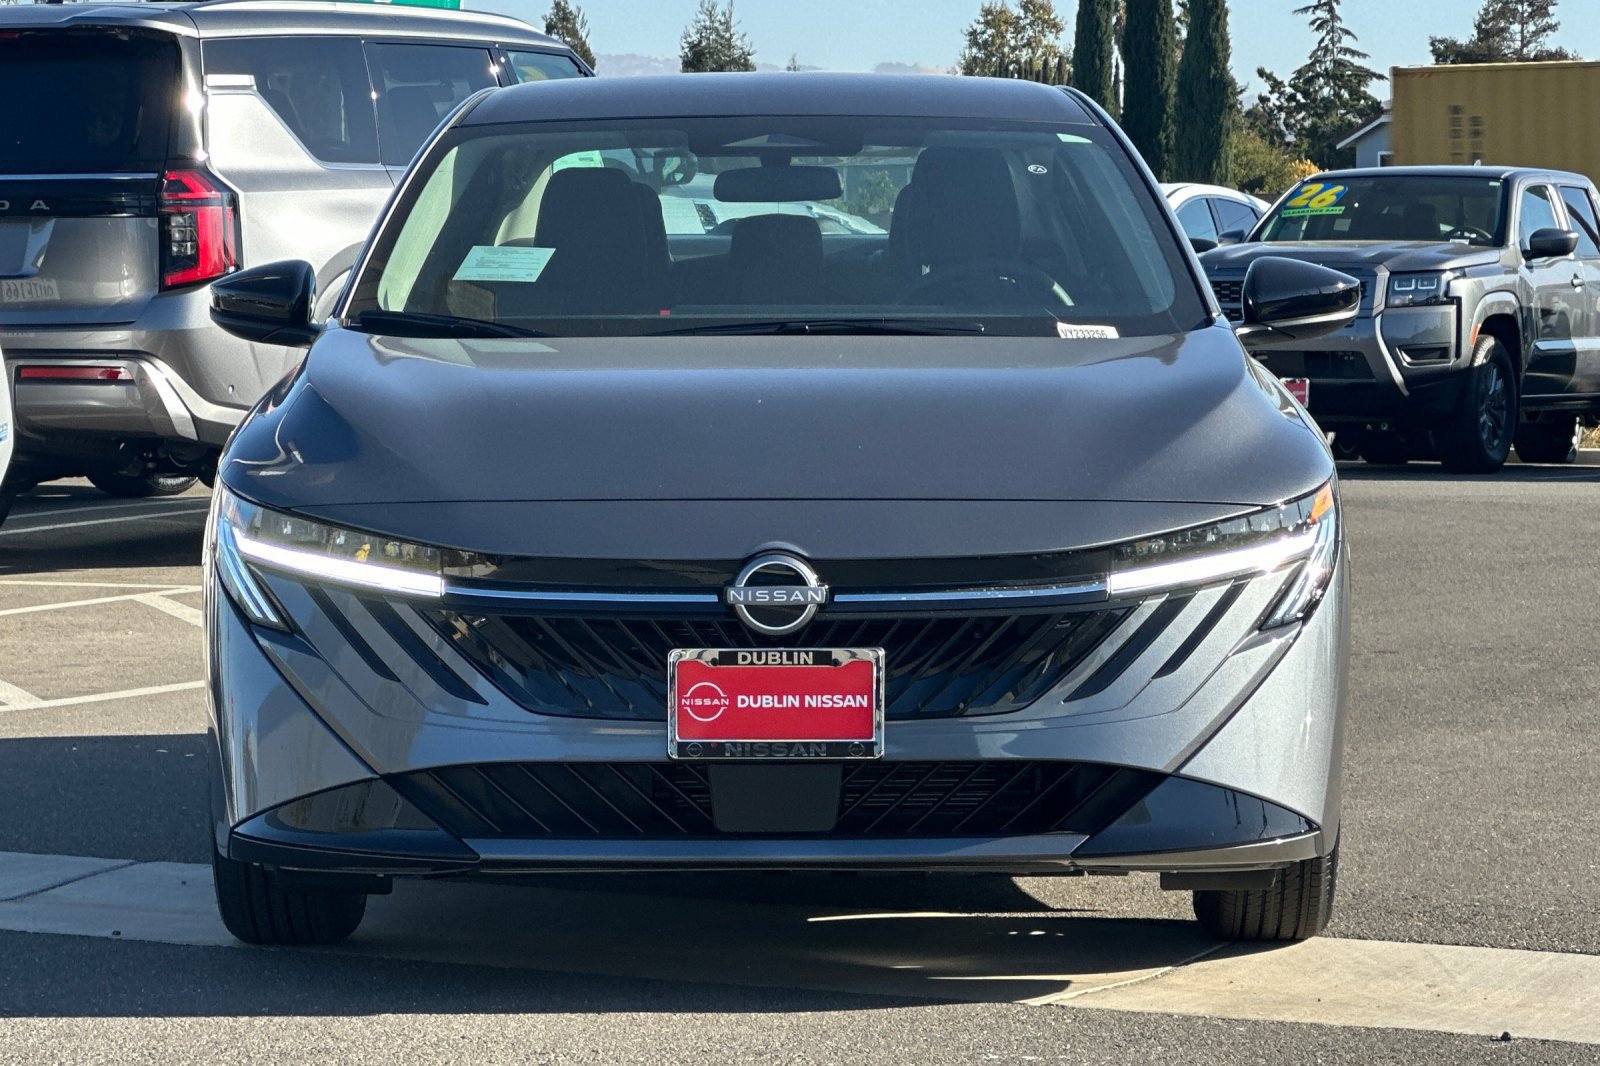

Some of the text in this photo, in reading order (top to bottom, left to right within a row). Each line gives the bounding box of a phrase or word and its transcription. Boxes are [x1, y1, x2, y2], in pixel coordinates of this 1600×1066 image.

[1287, 184, 1344, 208] 26
[729, 590, 822, 601] NISSAN
[737, 652, 813, 665] DUBLIN
[681, 698, 729, 706] NISSAN
[737, 695, 868, 708] DUBLIN NISSAN
[725, 743, 827, 757] NISSAN
